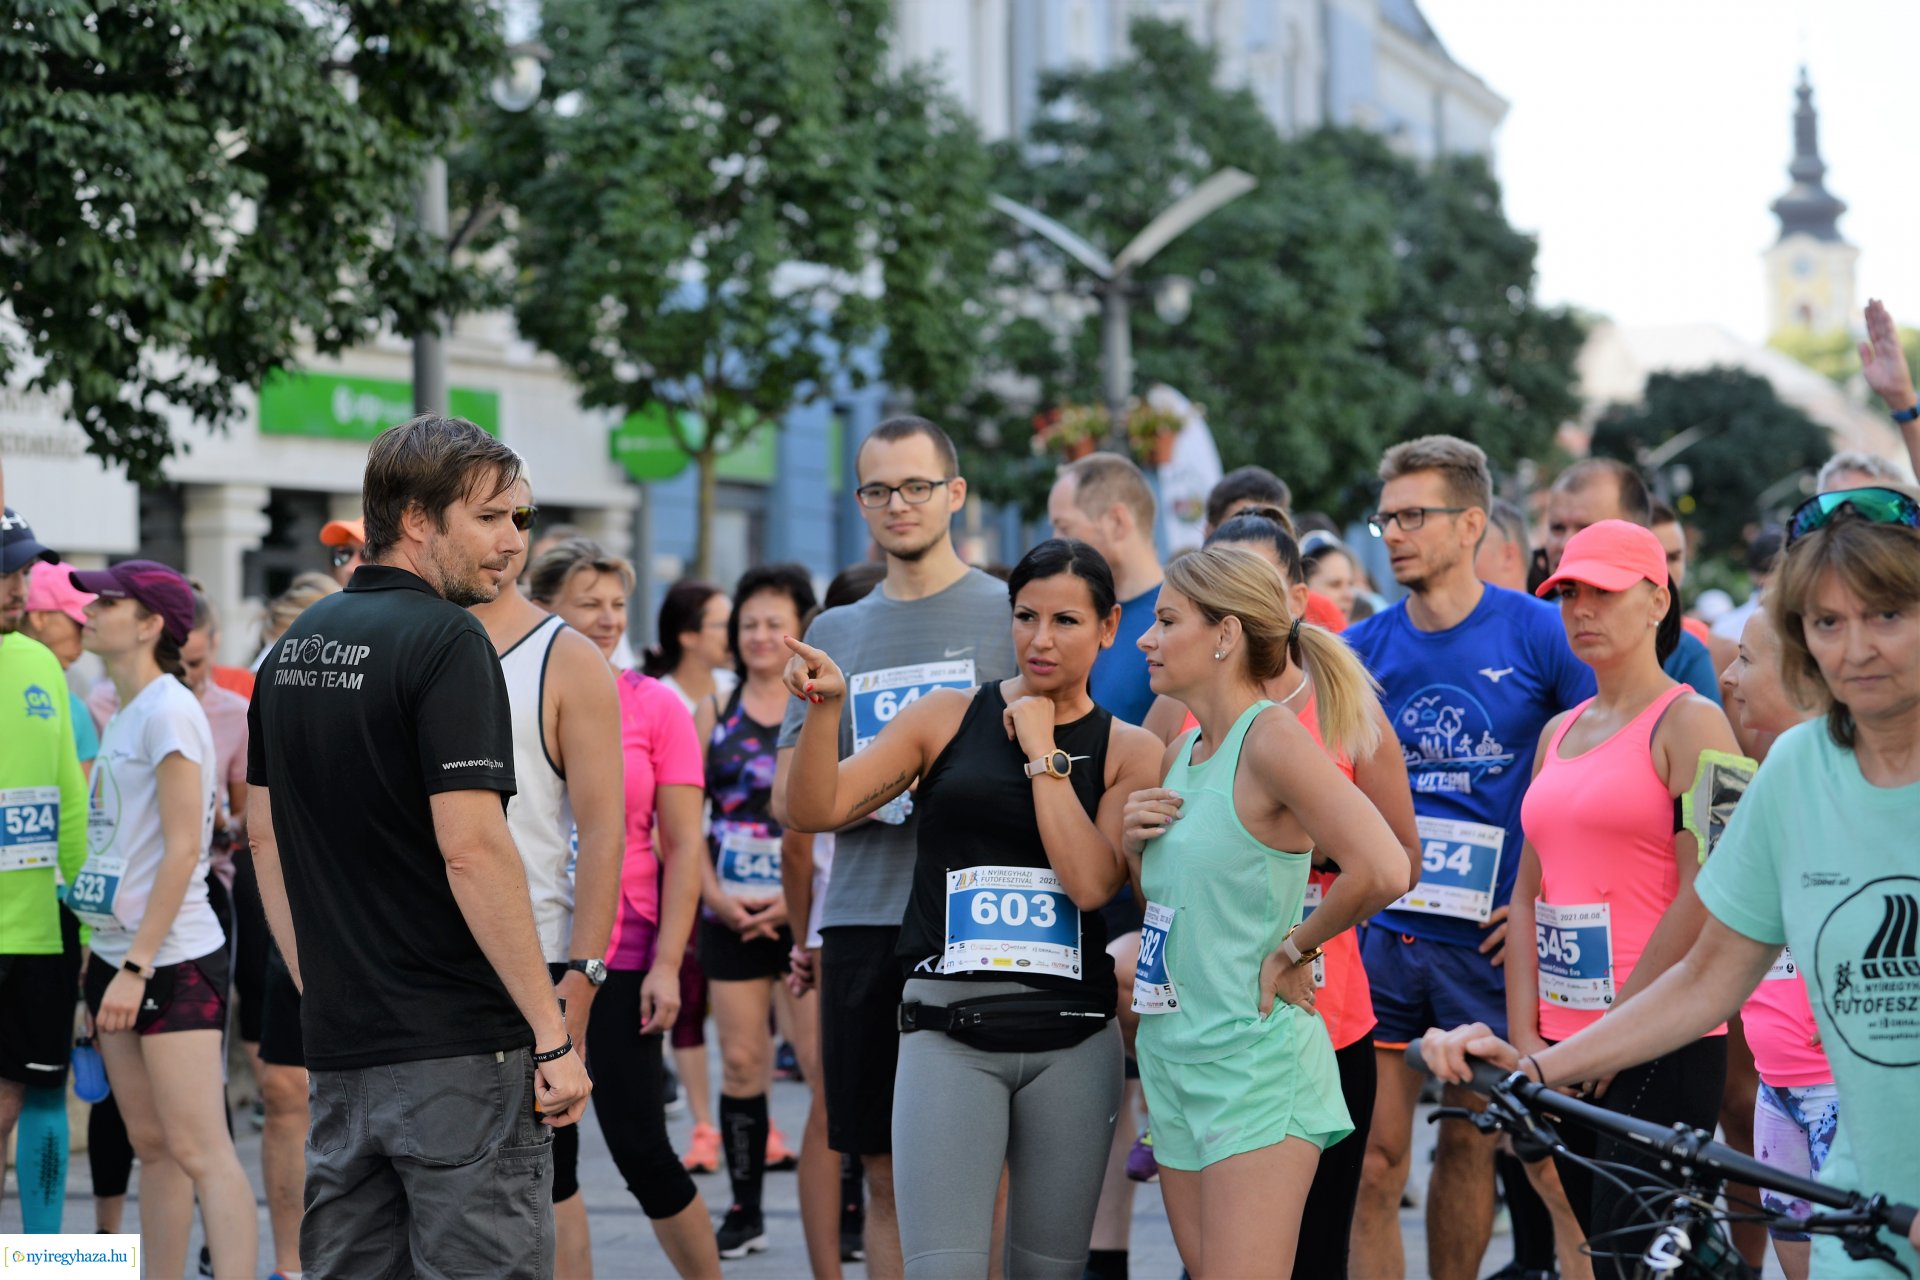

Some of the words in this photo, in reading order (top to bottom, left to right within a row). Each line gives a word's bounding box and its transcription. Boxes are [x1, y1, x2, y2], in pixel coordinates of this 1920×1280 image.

[274, 669, 318, 687] TIMING
[321, 671, 364, 690] TEAM
[874, 683, 941, 722] 64
[5, 804, 55, 835] 524
[73, 875, 106, 903] 523
[971, 891, 1057, 928] 603
[1138, 927, 1161, 967] 582
[1536, 925, 1580, 965] 545
